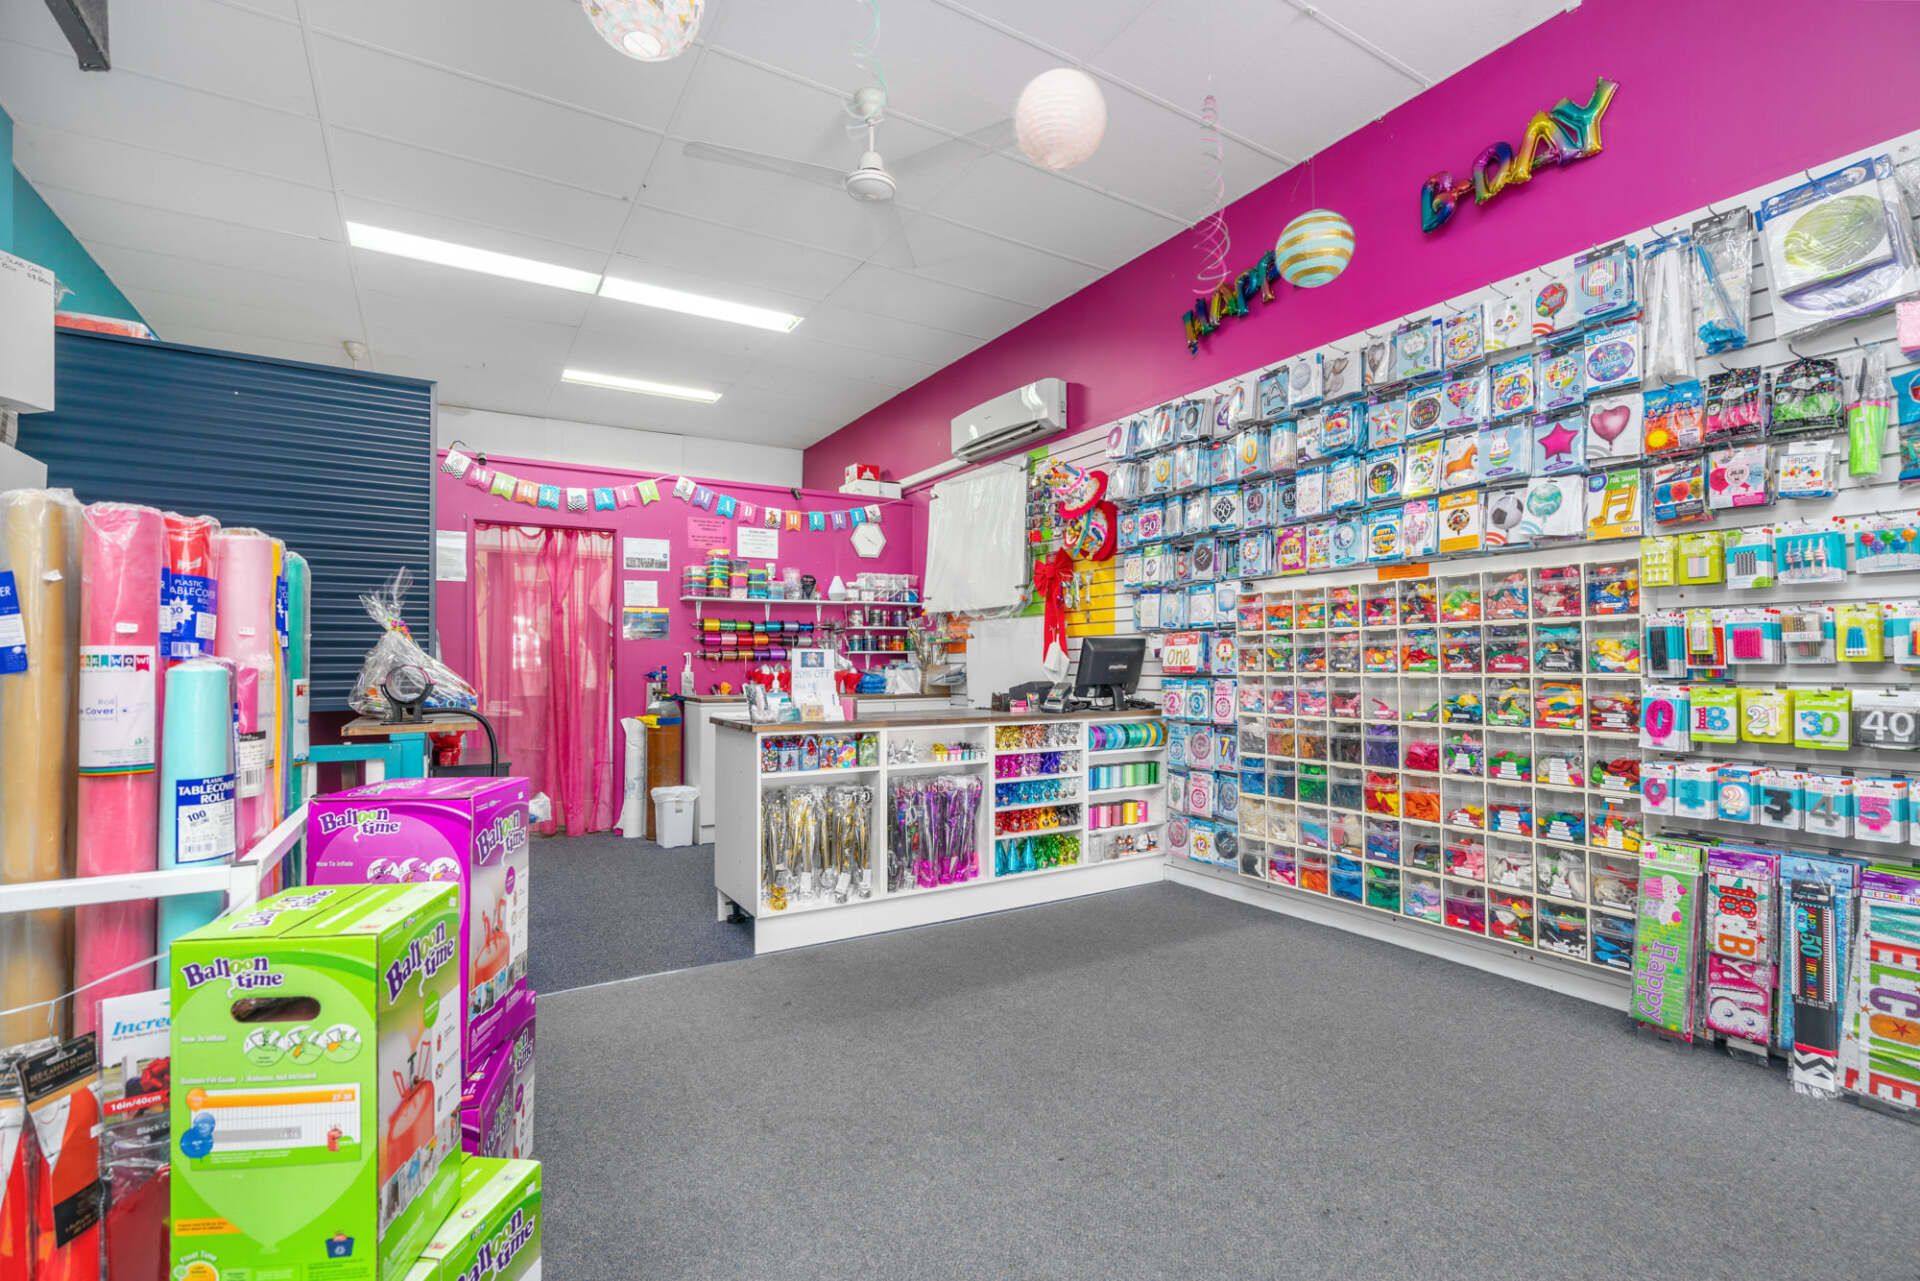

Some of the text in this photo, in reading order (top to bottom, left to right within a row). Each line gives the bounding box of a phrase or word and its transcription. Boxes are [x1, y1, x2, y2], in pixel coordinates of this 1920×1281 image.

[174, 578, 204, 588] PLASTIC
[1167, 648, 1190, 665] one
[85, 706, 114, 716] Cover
[1194, 696, 1202, 710] 3
[1695, 705, 1730, 731] 18
[1746, 704, 1782, 734] 21
[1800, 710, 1841, 737] 30
[1860, 710, 1915, 738] 40
[1220, 736, 1230, 757] 7
[200, 792, 226, 804] ROLL
[1763, 788, 1793, 818] 3
[1808, 795, 1841, 822] 4
[186, 809, 207, 822] 100
[320, 808, 389, 834] Balloon
[1858, 796, 1893, 828] 5
[361, 820, 400, 835] time
[477, 810, 520, 864] Balloon
[504, 826, 527, 852] time
[424, 938, 456, 976] time
[1800, 934, 1823, 958] 50
[183, 956, 269, 988] Balloon
[386, 921, 446, 1002] Balloon
[237, 971, 283, 989] time
[1636, 940, 1680, 1023] Happy
[110, 1095, 162, 1111] 16in/40cm
[497, 1216, 536, 1272] time
